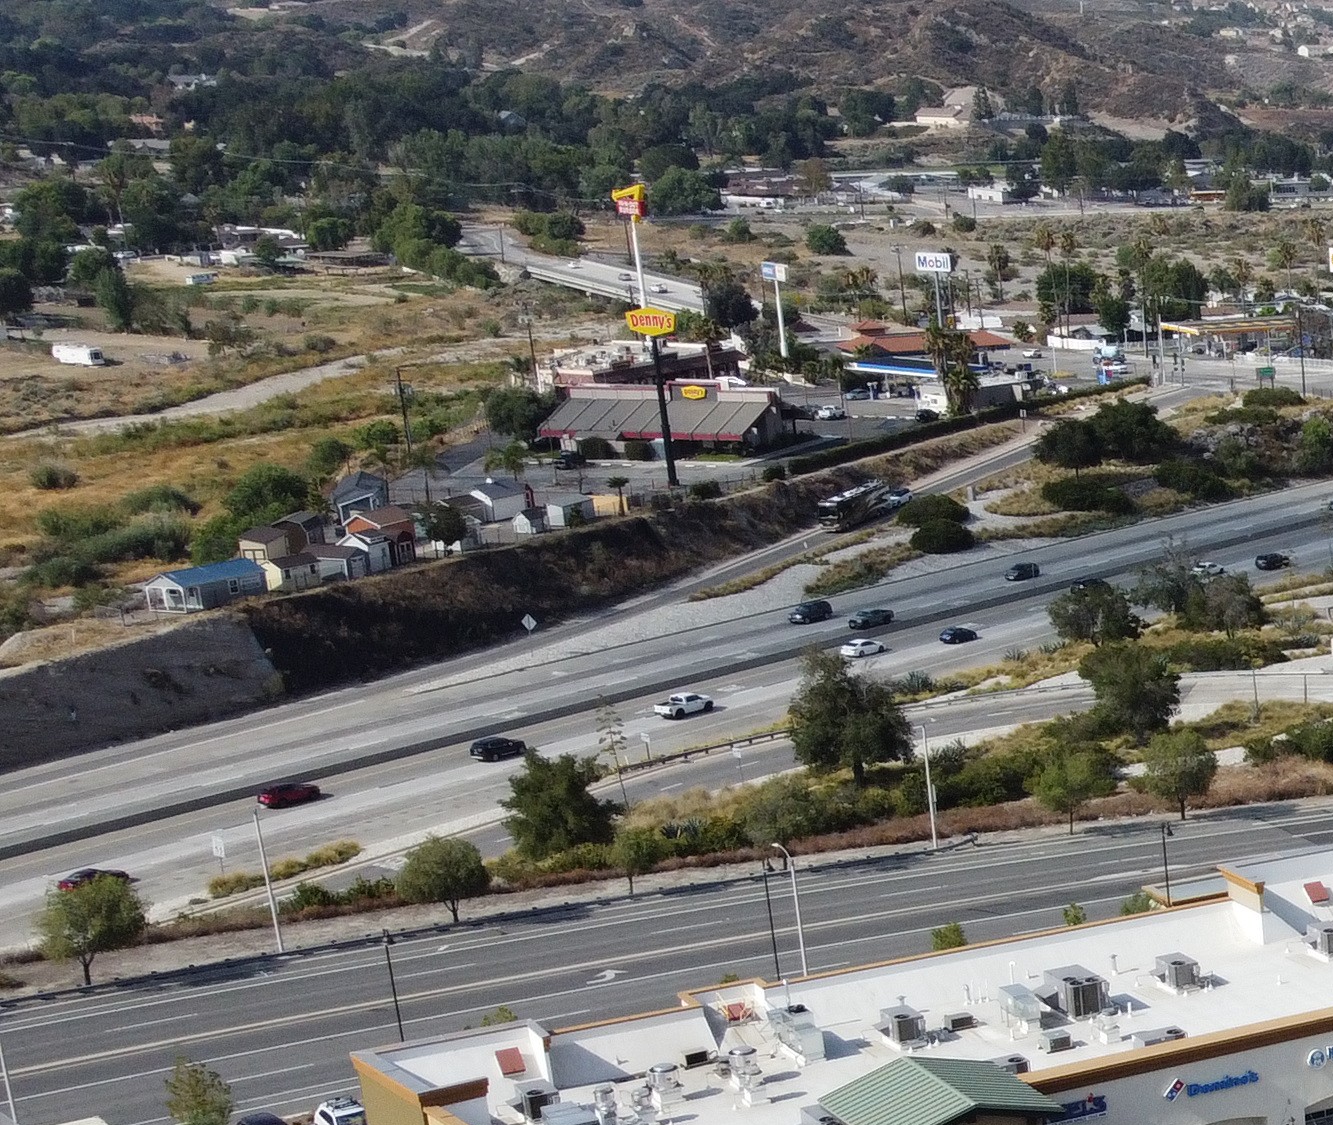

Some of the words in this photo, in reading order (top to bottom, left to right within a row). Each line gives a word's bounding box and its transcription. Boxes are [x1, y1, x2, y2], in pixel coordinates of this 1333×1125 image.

[917, 255, 949, 270] Mobil
[630, 313, 672, 329] Denny's
[1187, 1071, 1259, 1098] Domino's
